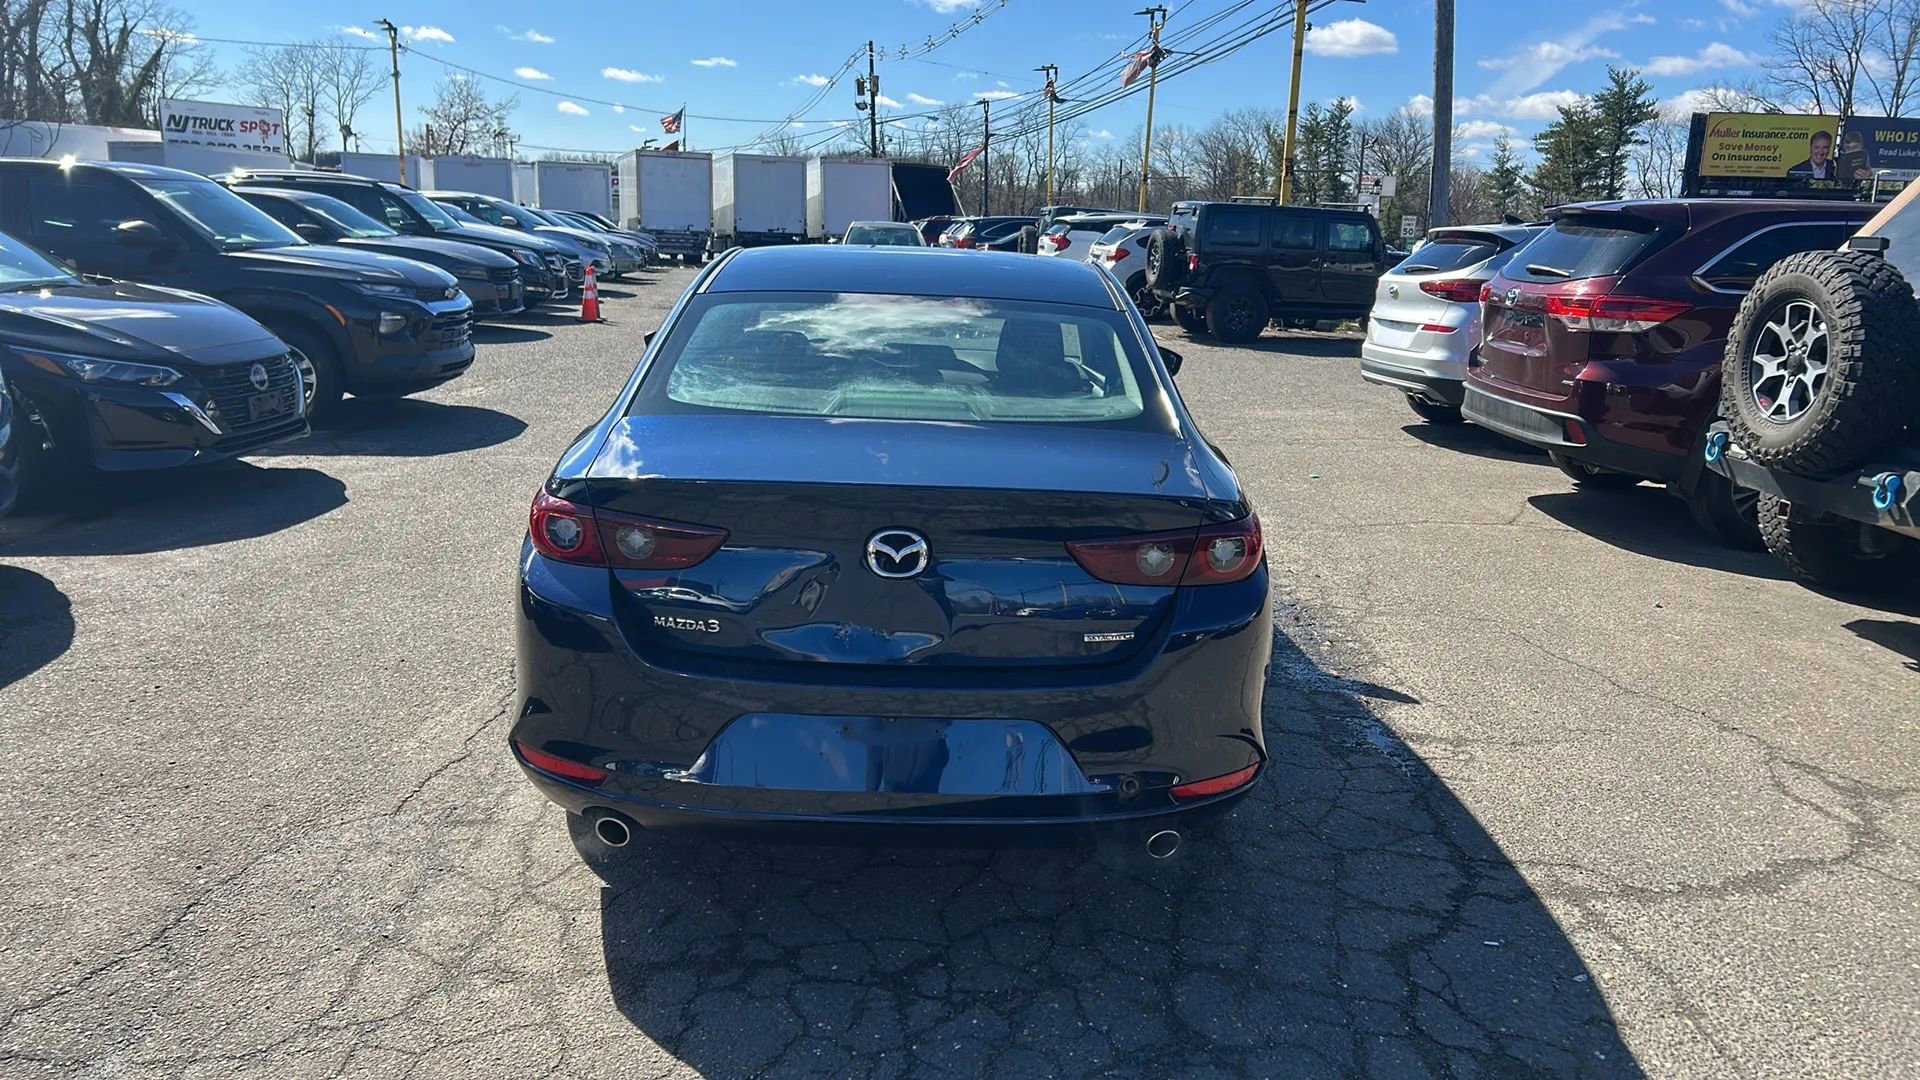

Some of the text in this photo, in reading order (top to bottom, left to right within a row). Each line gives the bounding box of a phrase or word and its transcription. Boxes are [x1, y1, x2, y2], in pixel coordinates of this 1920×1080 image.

[166, 114, 191, 133] NJ
[191, 116, 236, 132] TRUCK
[1709, 128, 1809, 140] Muller Insurance.com
[1875, 130, 1919, 143] WHO IS
[1718, 142, 1780, 154] Save Money
[1879, 148, 1898, 156] Read
[1712, 152, 1783, 162] On Insurance!
[1402, 227, 1414, 236] 50
